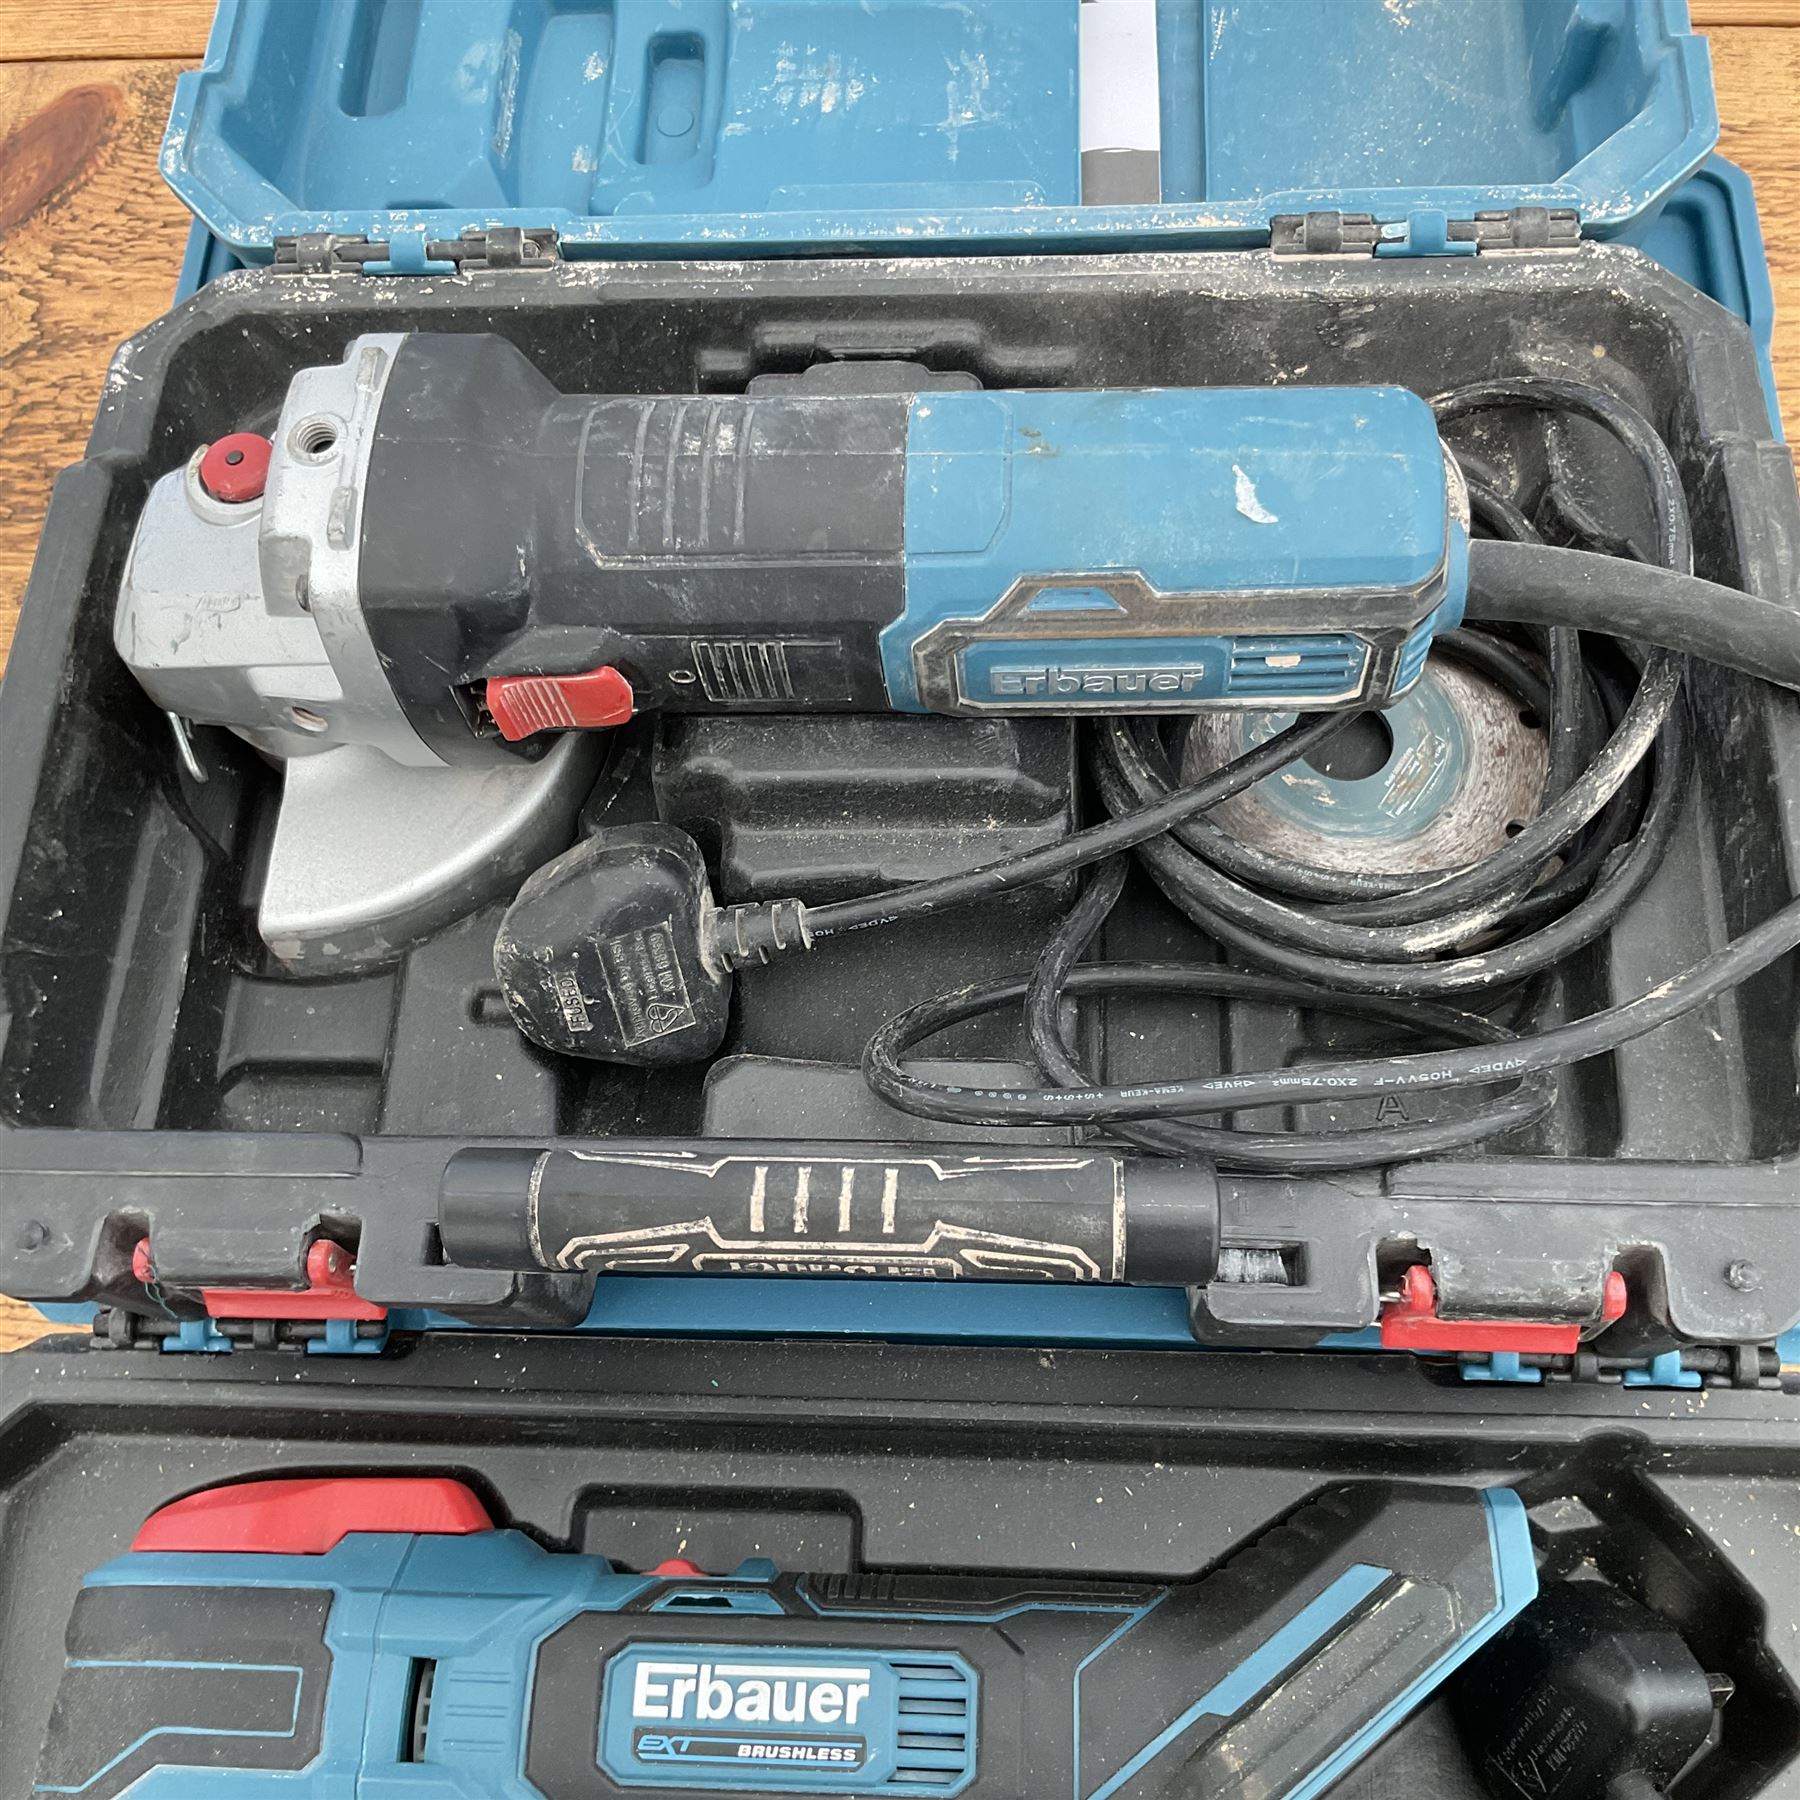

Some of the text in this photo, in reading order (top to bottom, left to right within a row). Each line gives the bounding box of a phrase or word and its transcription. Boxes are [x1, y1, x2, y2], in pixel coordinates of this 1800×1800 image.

[990, 664, 1204, 695] Erbauer
[560, 977, 586, 1025] FUSED
[1119, 1085, 1185, 1098] KEMA-KEUR
[1373, 1069, 1452, 1086] H05VV-F
[633, 1662, 870, 1724] Erbauer
[637, 1735, 857, 1761] EXT BRUSHLESS
